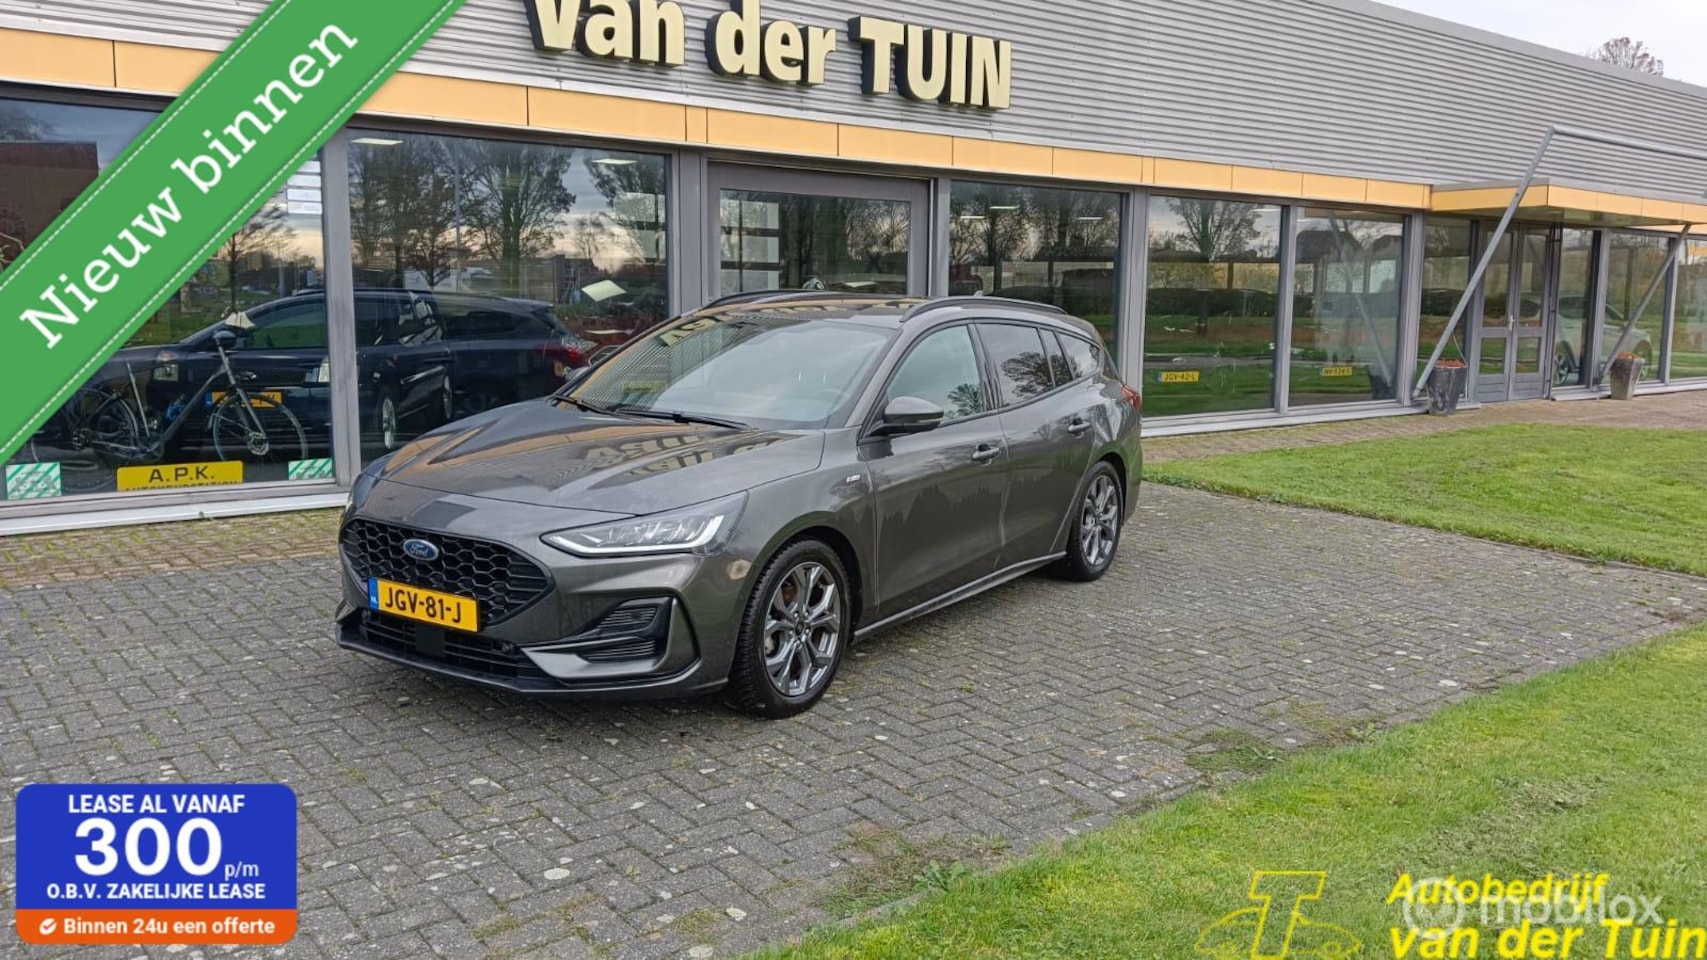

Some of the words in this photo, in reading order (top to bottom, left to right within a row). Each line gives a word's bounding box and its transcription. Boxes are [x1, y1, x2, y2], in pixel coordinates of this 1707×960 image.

[526, 0, 686, 66] van
[713, 0, 836, 84] der
[856, 16, 1012, 109] TUIN
[148, 466, 215, 483] A.P.K.
[385, 587, 462, 624] JGV-81-J
